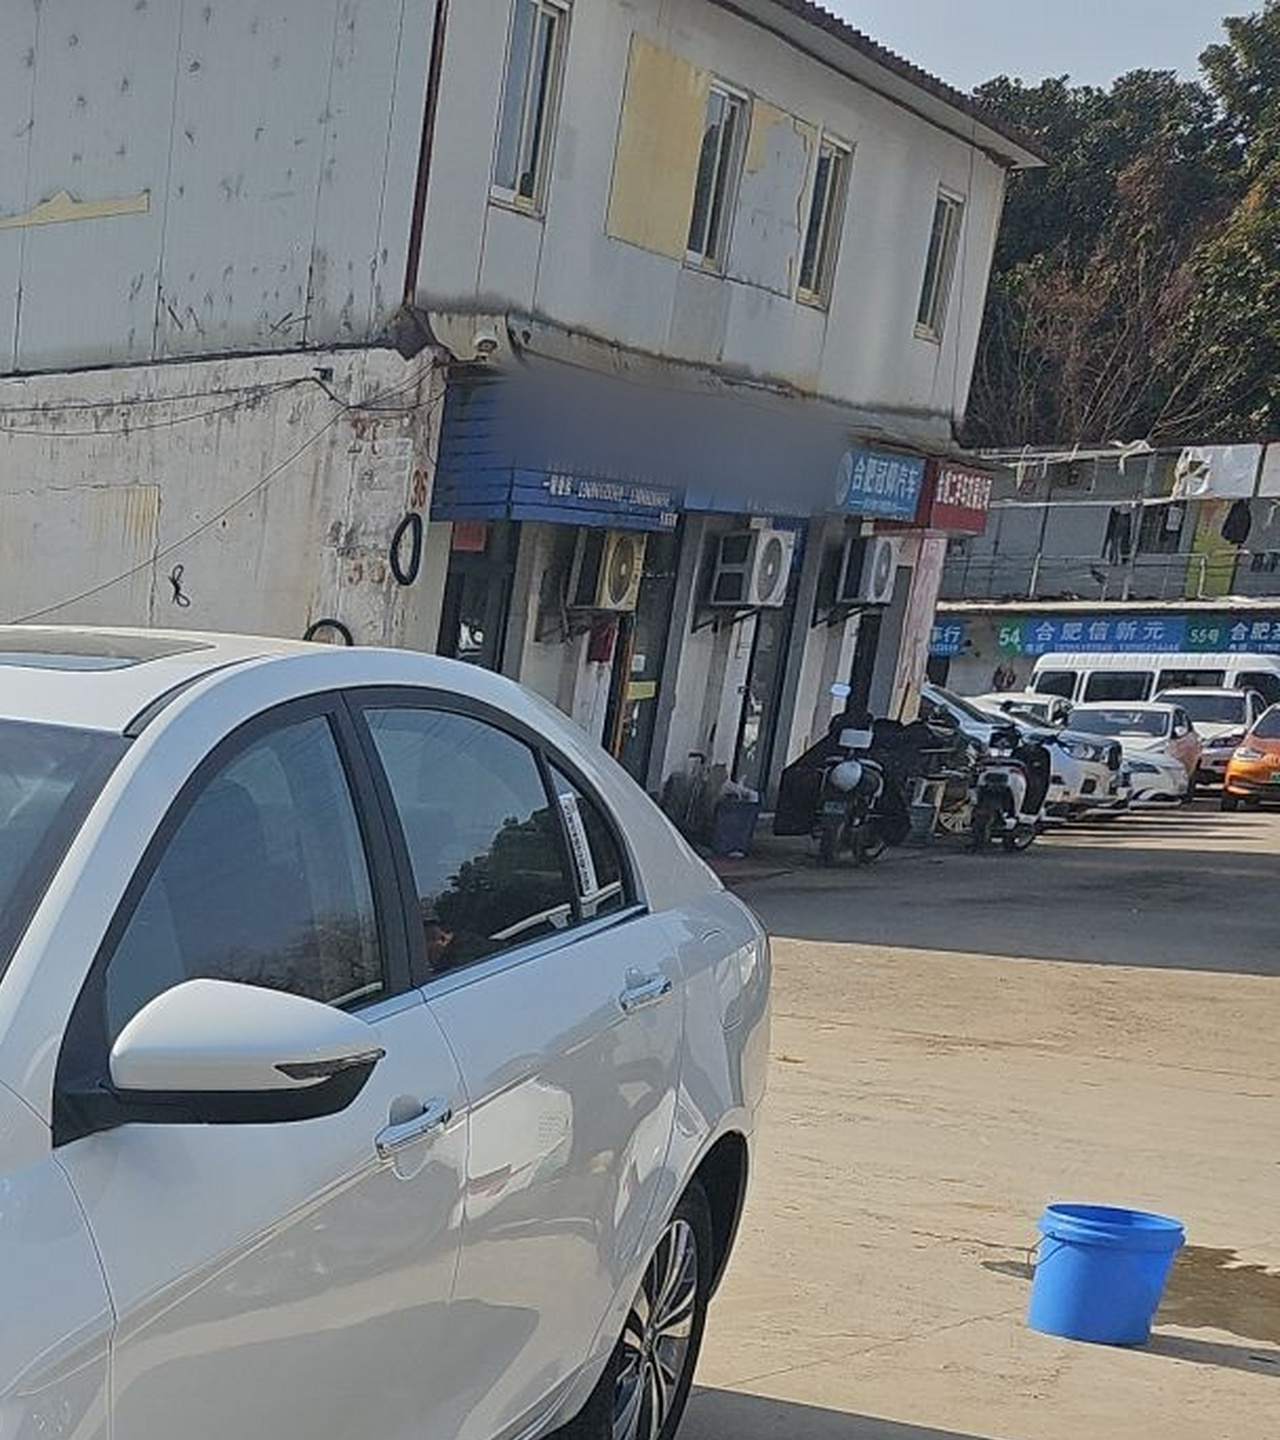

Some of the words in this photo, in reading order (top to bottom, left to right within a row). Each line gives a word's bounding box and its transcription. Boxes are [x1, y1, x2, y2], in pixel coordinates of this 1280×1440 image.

[1035, 621, 1164, 642] 合肥信新元
